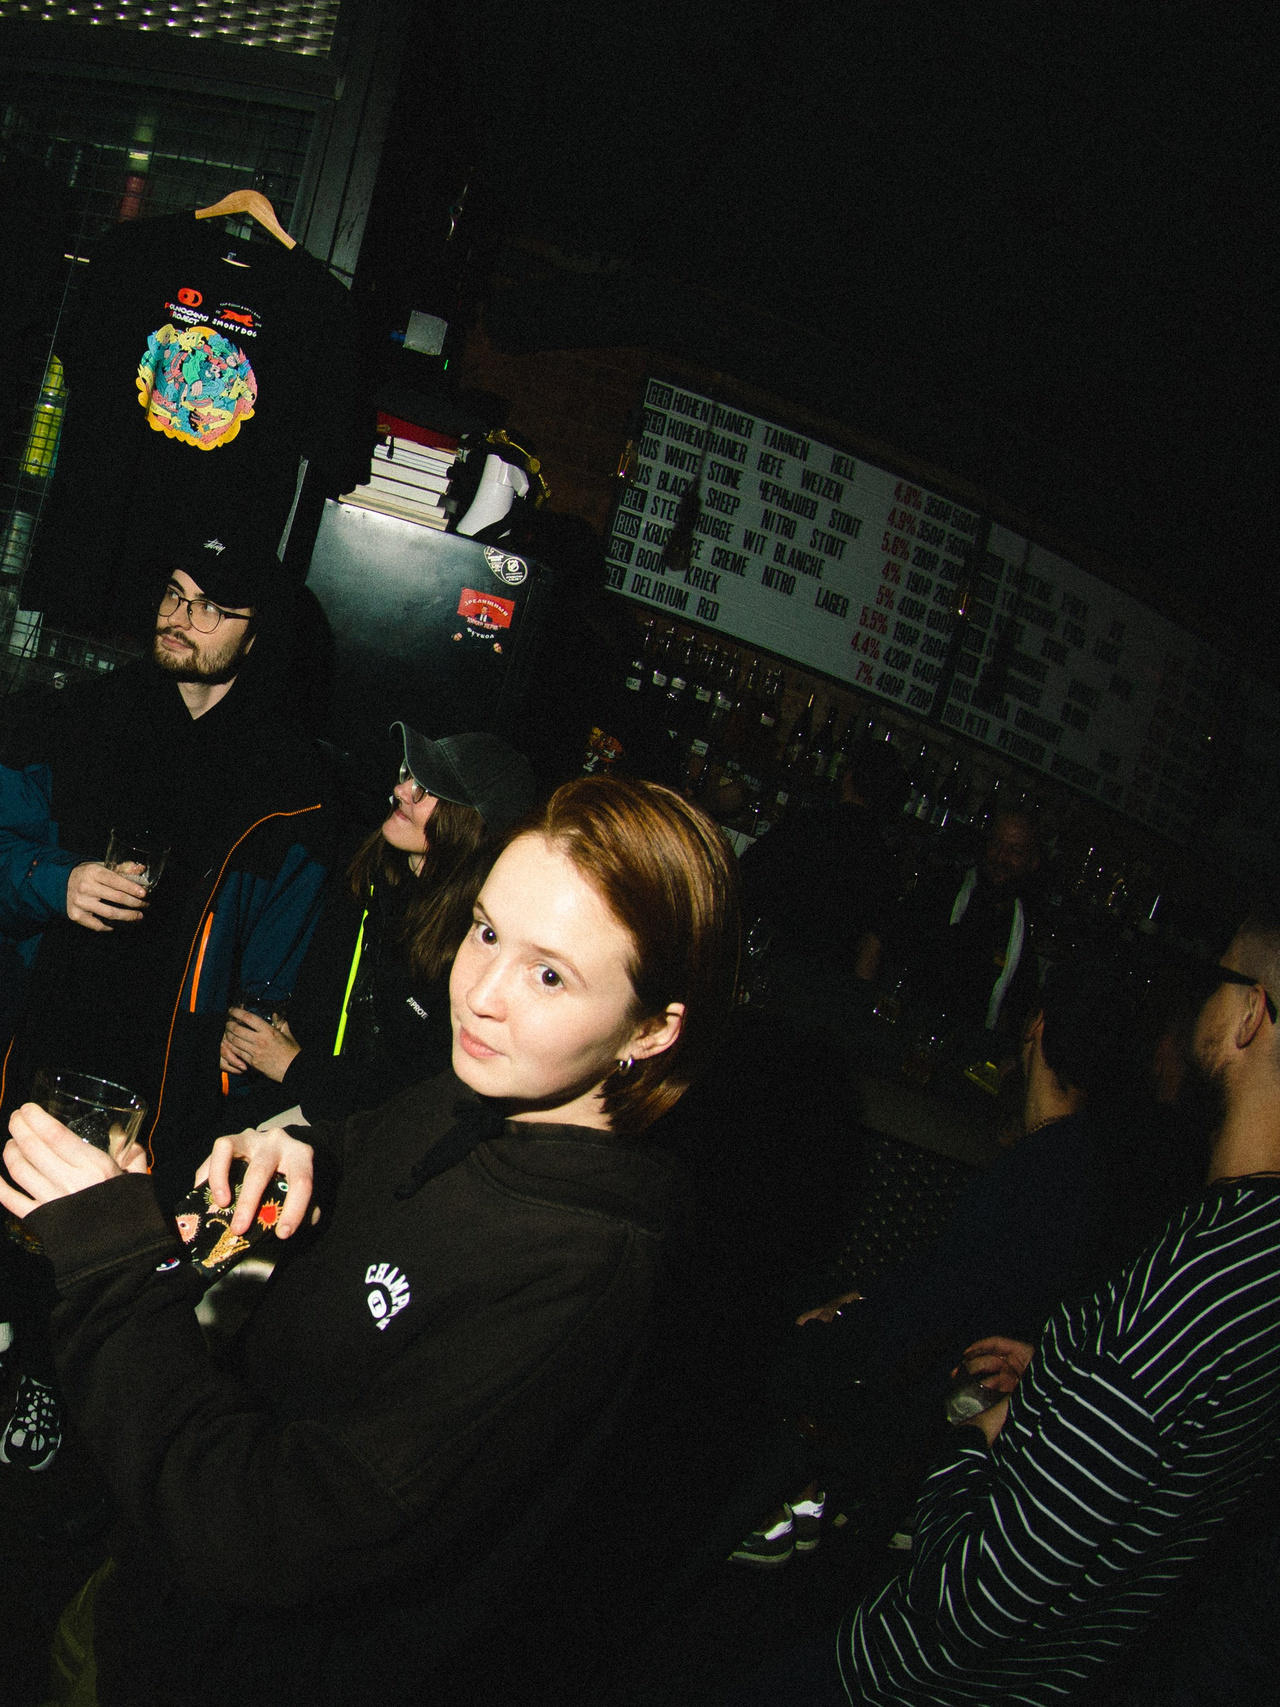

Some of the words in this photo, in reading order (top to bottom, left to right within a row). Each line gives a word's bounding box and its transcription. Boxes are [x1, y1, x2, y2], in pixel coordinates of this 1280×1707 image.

[212, 318, 240, 332] SMOKY
[240, 327, 257, 338] DOG
[649, 384, 671, 407] GER
[830, 452, 855, 481] HELL
[757, 451, 786, 479] HEFE
[635, 462, 652, 486] US
[705, 487, 741, 517] SHEEP
[760, 508, 797, 540] NITRO
[809, 528, 847, 560] STOUT
[882, 560, 901, 586] 4%
[665, 443, 700, 475] WHITE
[829, 507, 863, 539] STOUT
[611, 541, 631, 564] BEL
[635, 547, 666, 576] BOON
[684, 565, 722, 594] KRIEK
[850, 631, 880, 660] 4.4%
[617, 512, 640, 537] RUS
[642, 520, 704, 560] KRUSCE
[710, 546, 750, 578] CREME
[762, 565, 796, 596] NITRO
[815, 586, 849, 618] LAGER
[859, 605, 888, 636] 5.5%
[623, 488, 645, 510] BEL
[651, 494, 734, 544] STEERUGGE
[743, 528, 768, 556] WIT
[773, 542, 826, 580] BLANCHE
[875, 585, 895, 611] 5%
[631, 573, 689, 612] DELIRIUM
[696, 595, 720, 622] RED
[855, 660, 873, 687] 7%
